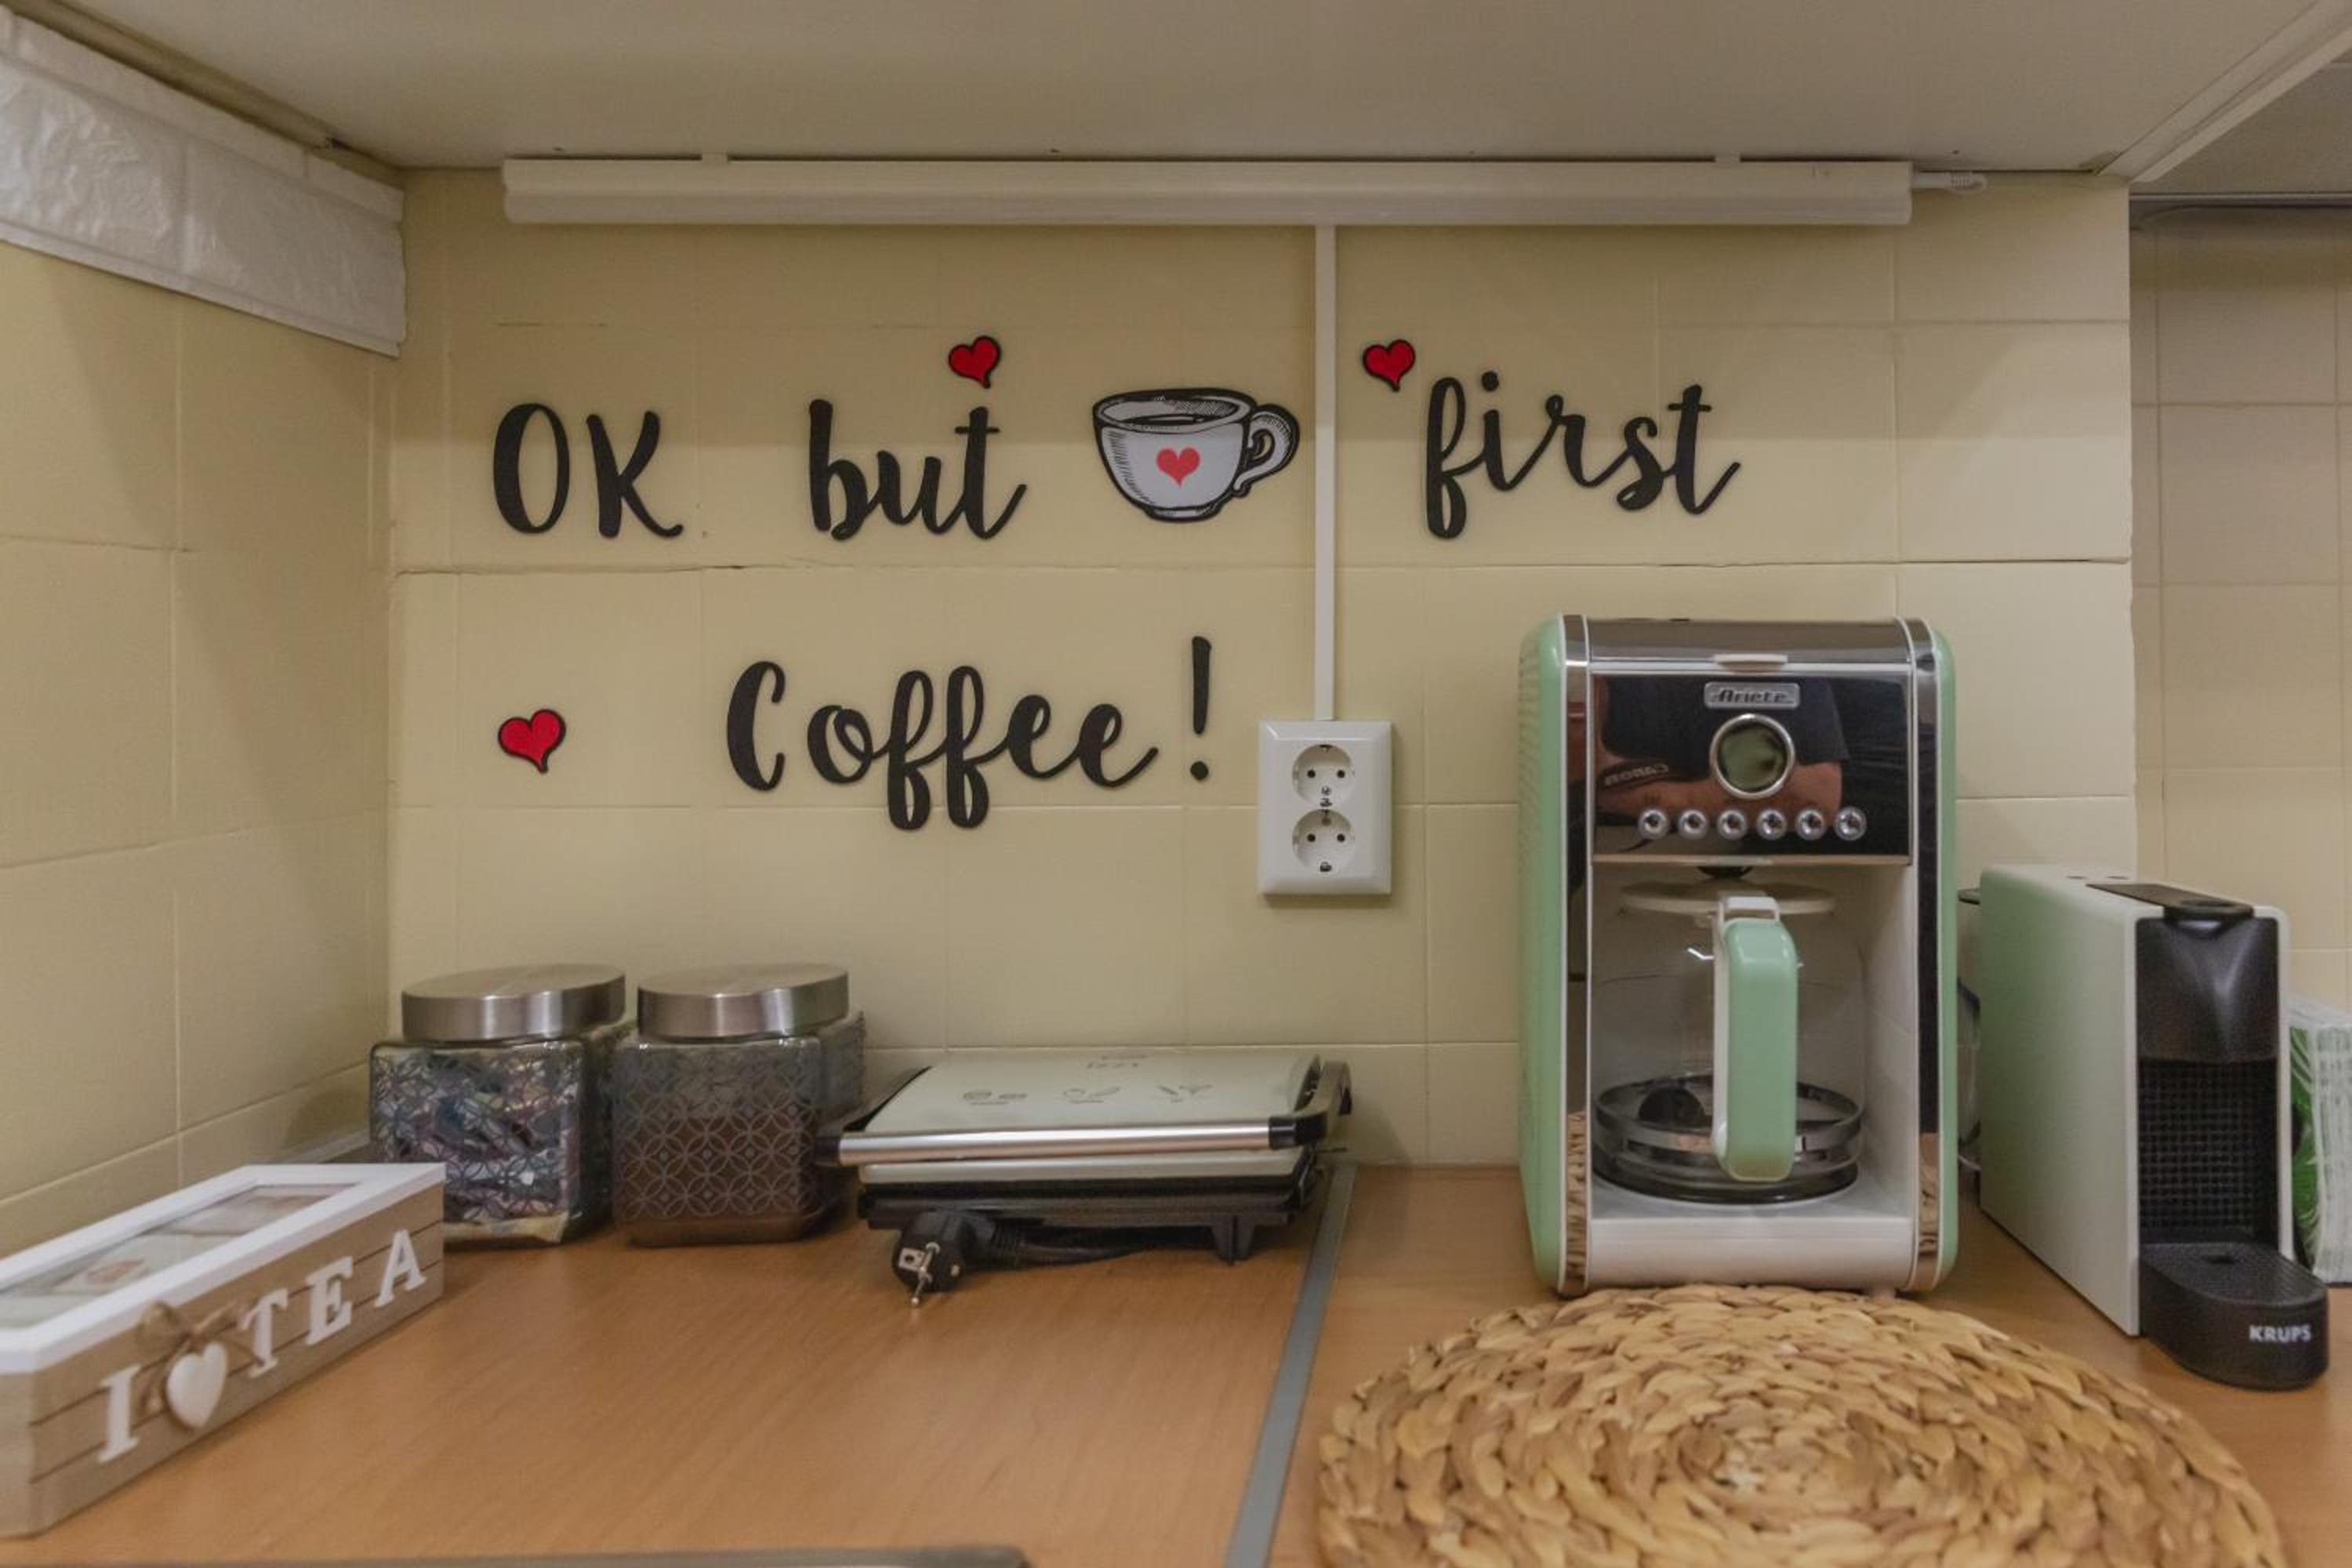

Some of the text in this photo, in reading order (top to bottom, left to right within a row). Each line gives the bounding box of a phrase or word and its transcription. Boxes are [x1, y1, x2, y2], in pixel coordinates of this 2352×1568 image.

[492, 370, 1740, 541] OK but first
[1714, 688, 1794, 703] Ariete
[99, 1229, 428, 1462] I TEA
[2249, 1325, 2311, 1342] KRUPS
